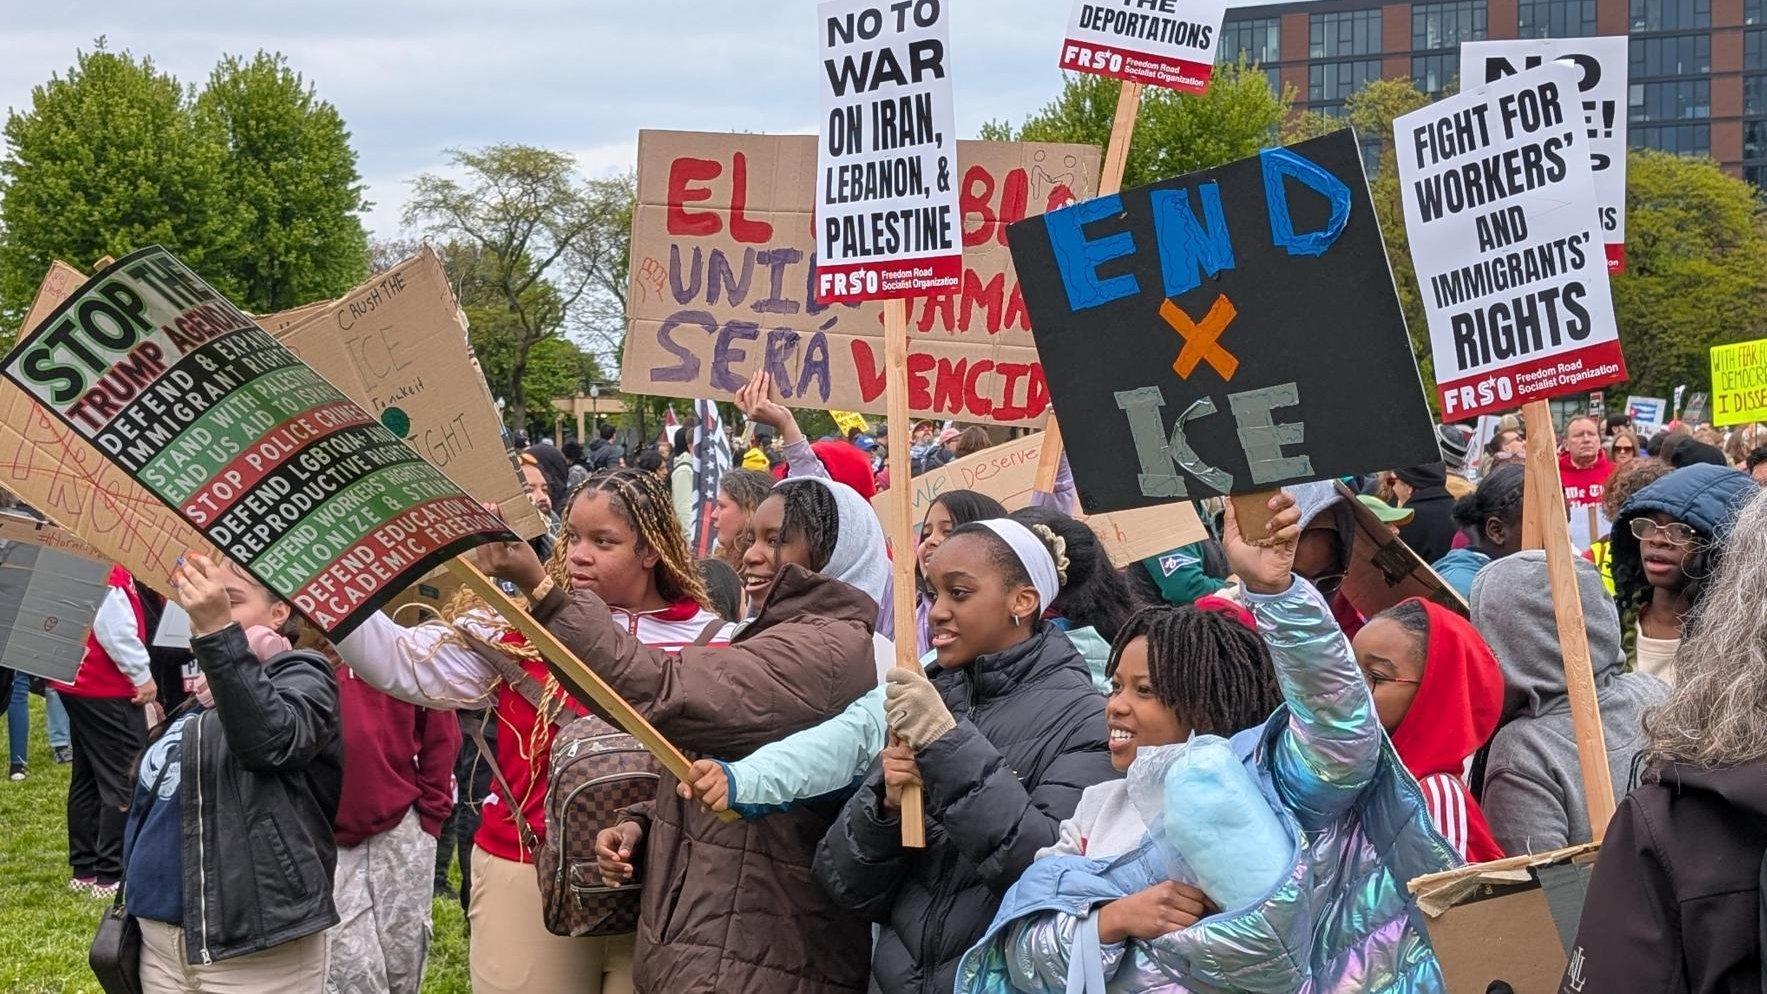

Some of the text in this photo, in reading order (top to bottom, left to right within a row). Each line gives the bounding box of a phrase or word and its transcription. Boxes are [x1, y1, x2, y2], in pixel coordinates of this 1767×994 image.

[827, 0, 941, 47] NO TO
[1078, 4, 1213, 51] DEPORTATIONS
[824, 38, 945, 97] WAR
[1124, 65, 1204, 88] Socialist Organization
[1126, 57, 1180, 74] Freedom Road
[828, 92, 943, 157] ON IRAN,
[1413, 103, 1492, 170] FIGHT
[1499, 81, 1564, 140] FOR
[666, 151, 774, 243] EL
[825, 155, 951, 205] LEBANON, &
[825, 205, 953, 260] PALESTINE
[1044, 146, 1352, 311] END
[1474, 204, 1528, 253] AND
[380, 271, 407, 302] THE
[881, 266, 933, 281] Freedom Road
[881, 276, 958, 291] Socialist Organization
[20, 255, 217, 404] STOP THE
[345, 325, 412, 393] ICE
[1451, 281, 1592, 371] RIGHTS
[1712, 348, 1736, 373] WITH
[65, 302, 253, 432] TRUMP AGENDA
[98, 329, 278, 456] DEFEND & EXPAND
[649, 310, 1052, 421] SERÁ VENCID
[1515, 359, 1583, 384] Freedom Road
[1518, 363, 1619, 396] Socialist Organization
[1718, 395, 1729, 414] I
[1734, 388, 1767, 413] DISSE
[117, 348, 300, 472] IMMIGRANT RIGHTS
[145, 427, 213, 488] STAND
[208, 389, 258, 430] WITH
[164, 463, 208, 503] END
[207, 435, 241, 464] US
[241, 408, 276, 441] AID
[271, 394, 299, 416] TO
[406, 412, 474, 468] IGHT
[1114, 381, 1315, 498] ICE
[185, 402, 372, 525] STOP POLICE CRIMES
[208, 425, 398, 547] DEFEND LGBTQIA+ AND
[911, 446, 1039, 510] We Deserve
[229, 442, 419, 564] REPRODUCTIVE RIGHTS
[253, 523, 319, 580] DEFEND
[382, 464, 424, 486] RIGHTS
[272, 478, 461, 595] UNIONIZE & STRIKE
[293, 544, 375, 615] DEFEND
[373, 499, 469, 548] EDUCATION
[313, 512, 505, 632] ACADEMIC FREEDOM
